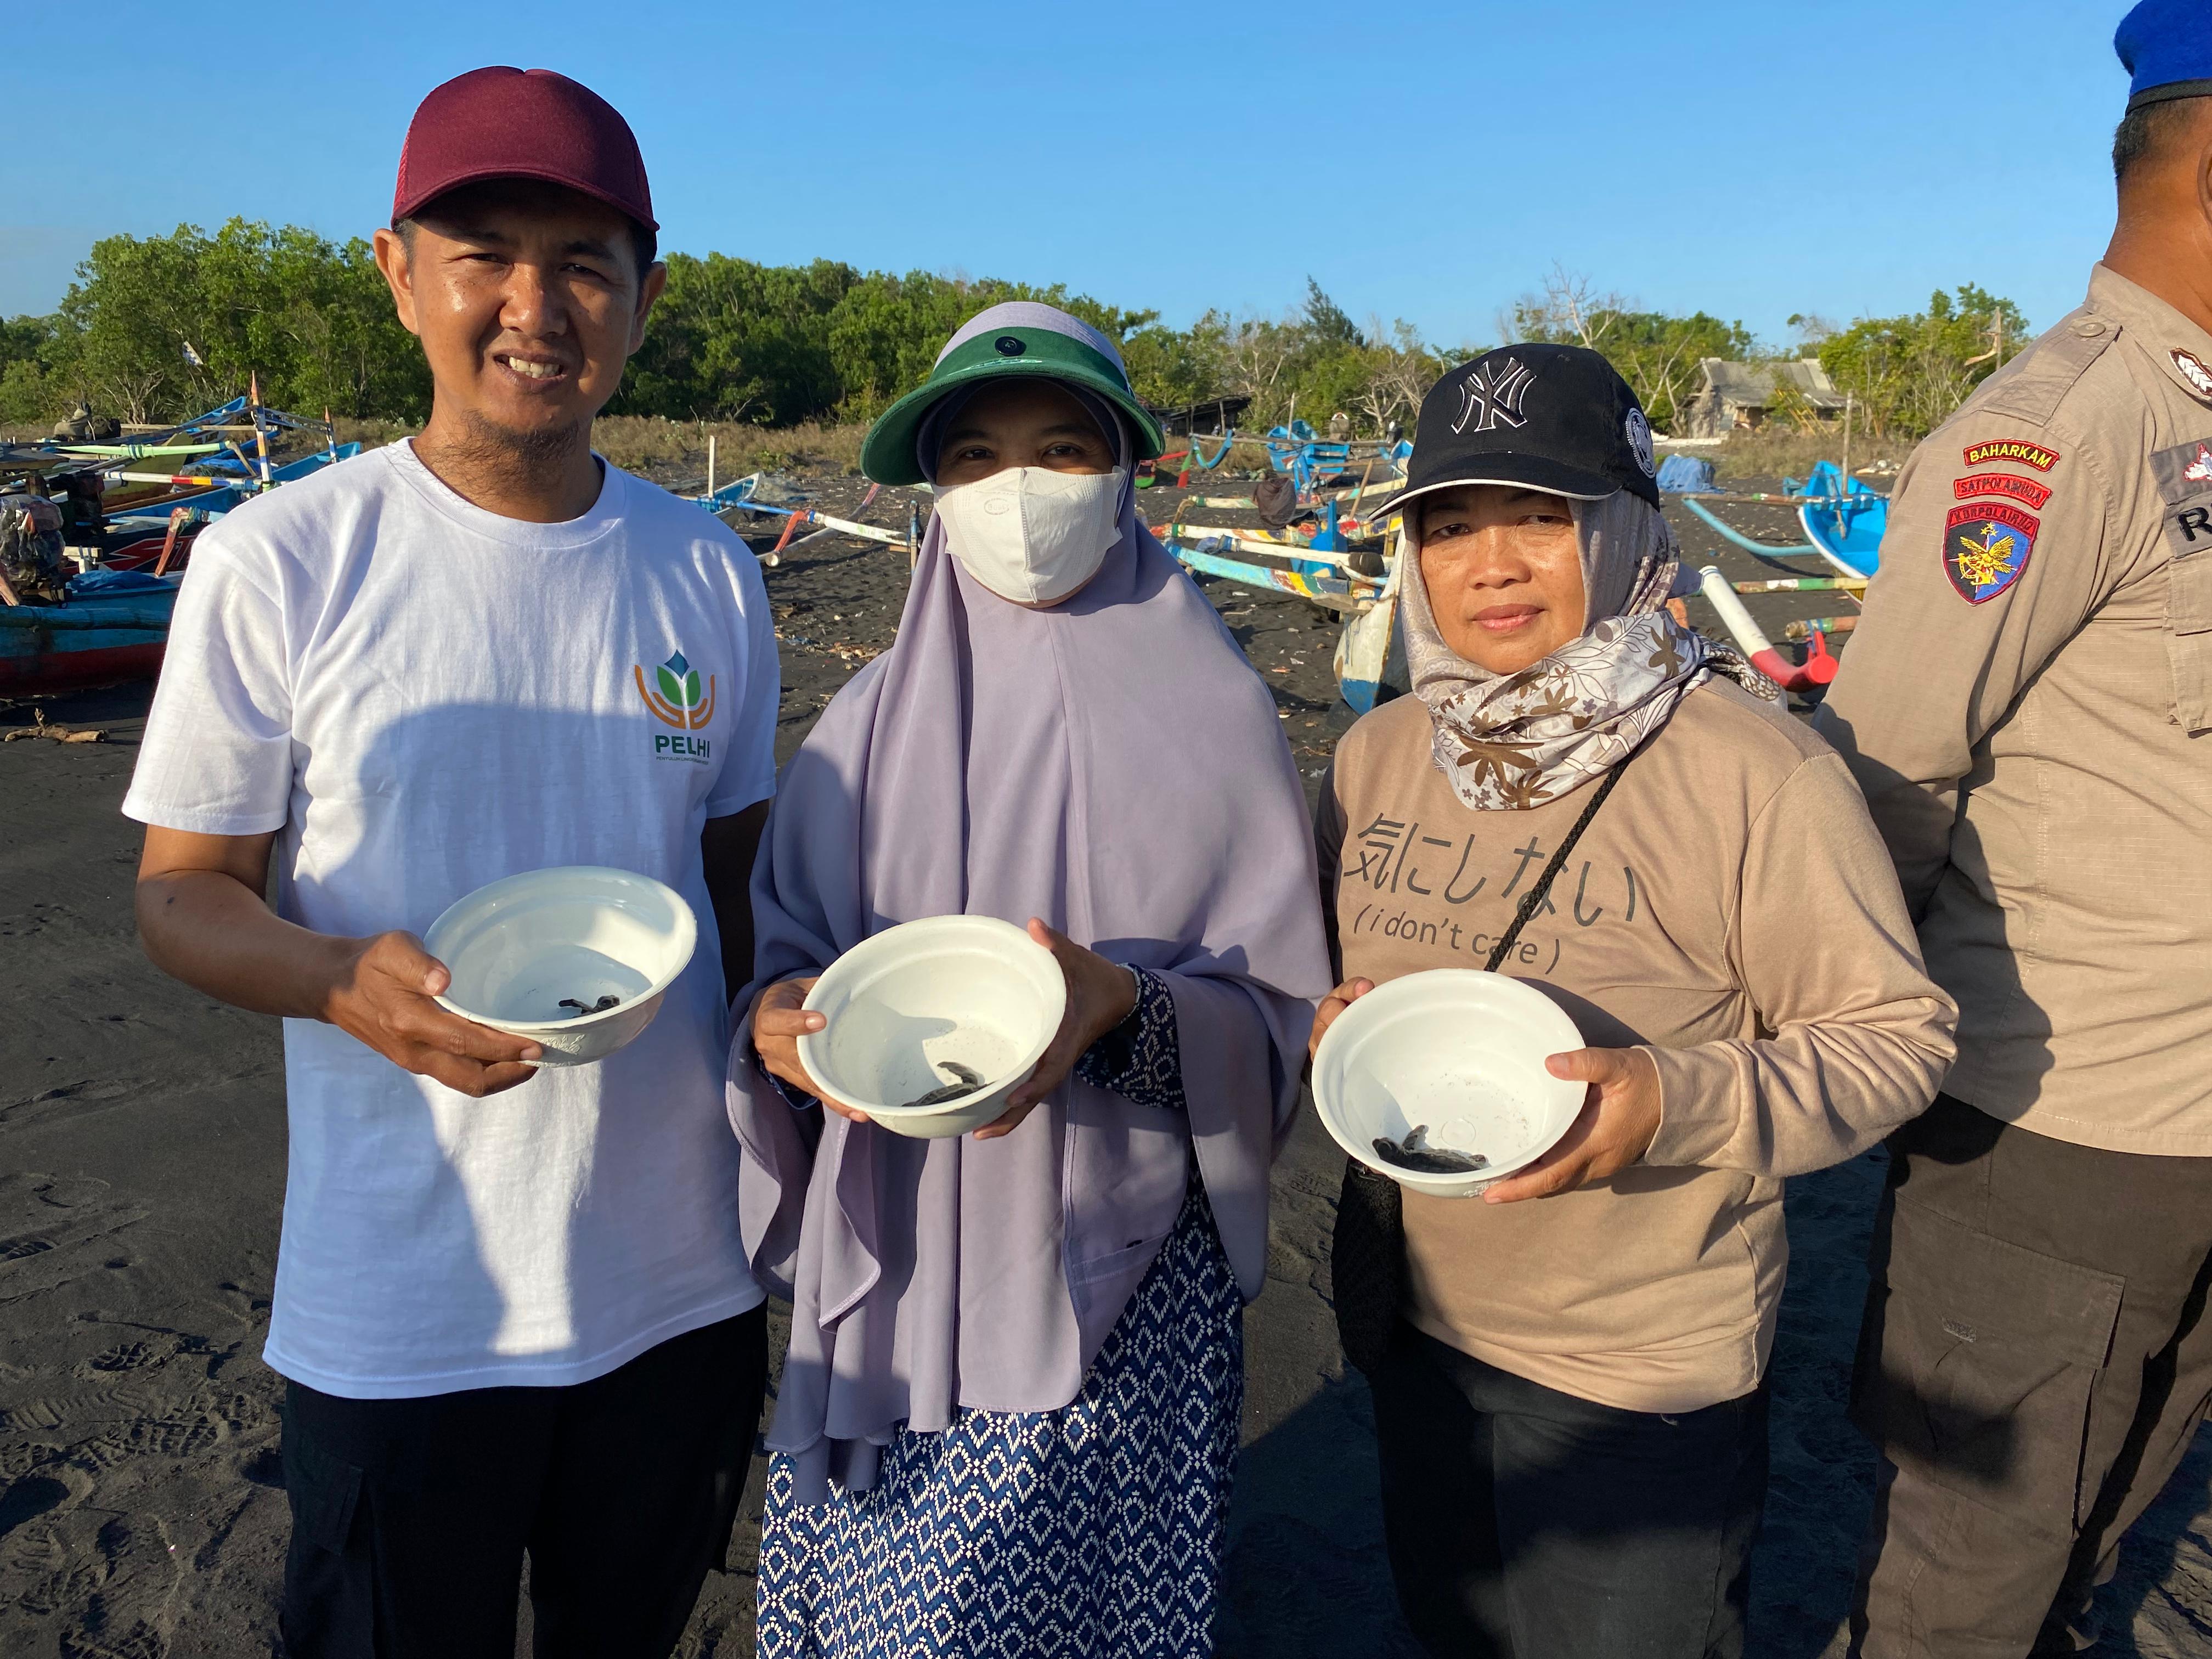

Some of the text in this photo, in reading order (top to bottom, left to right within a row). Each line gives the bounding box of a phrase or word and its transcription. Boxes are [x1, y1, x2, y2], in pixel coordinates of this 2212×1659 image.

[1970, 443, 2052, 468] BAHARKAM
[2176, 504, 2212, 541] R
[655, 735, 710, 758] PELHI
[1344, 812, 1635, 927] 気にしない
[1384, 911, 1463, 950] don't
